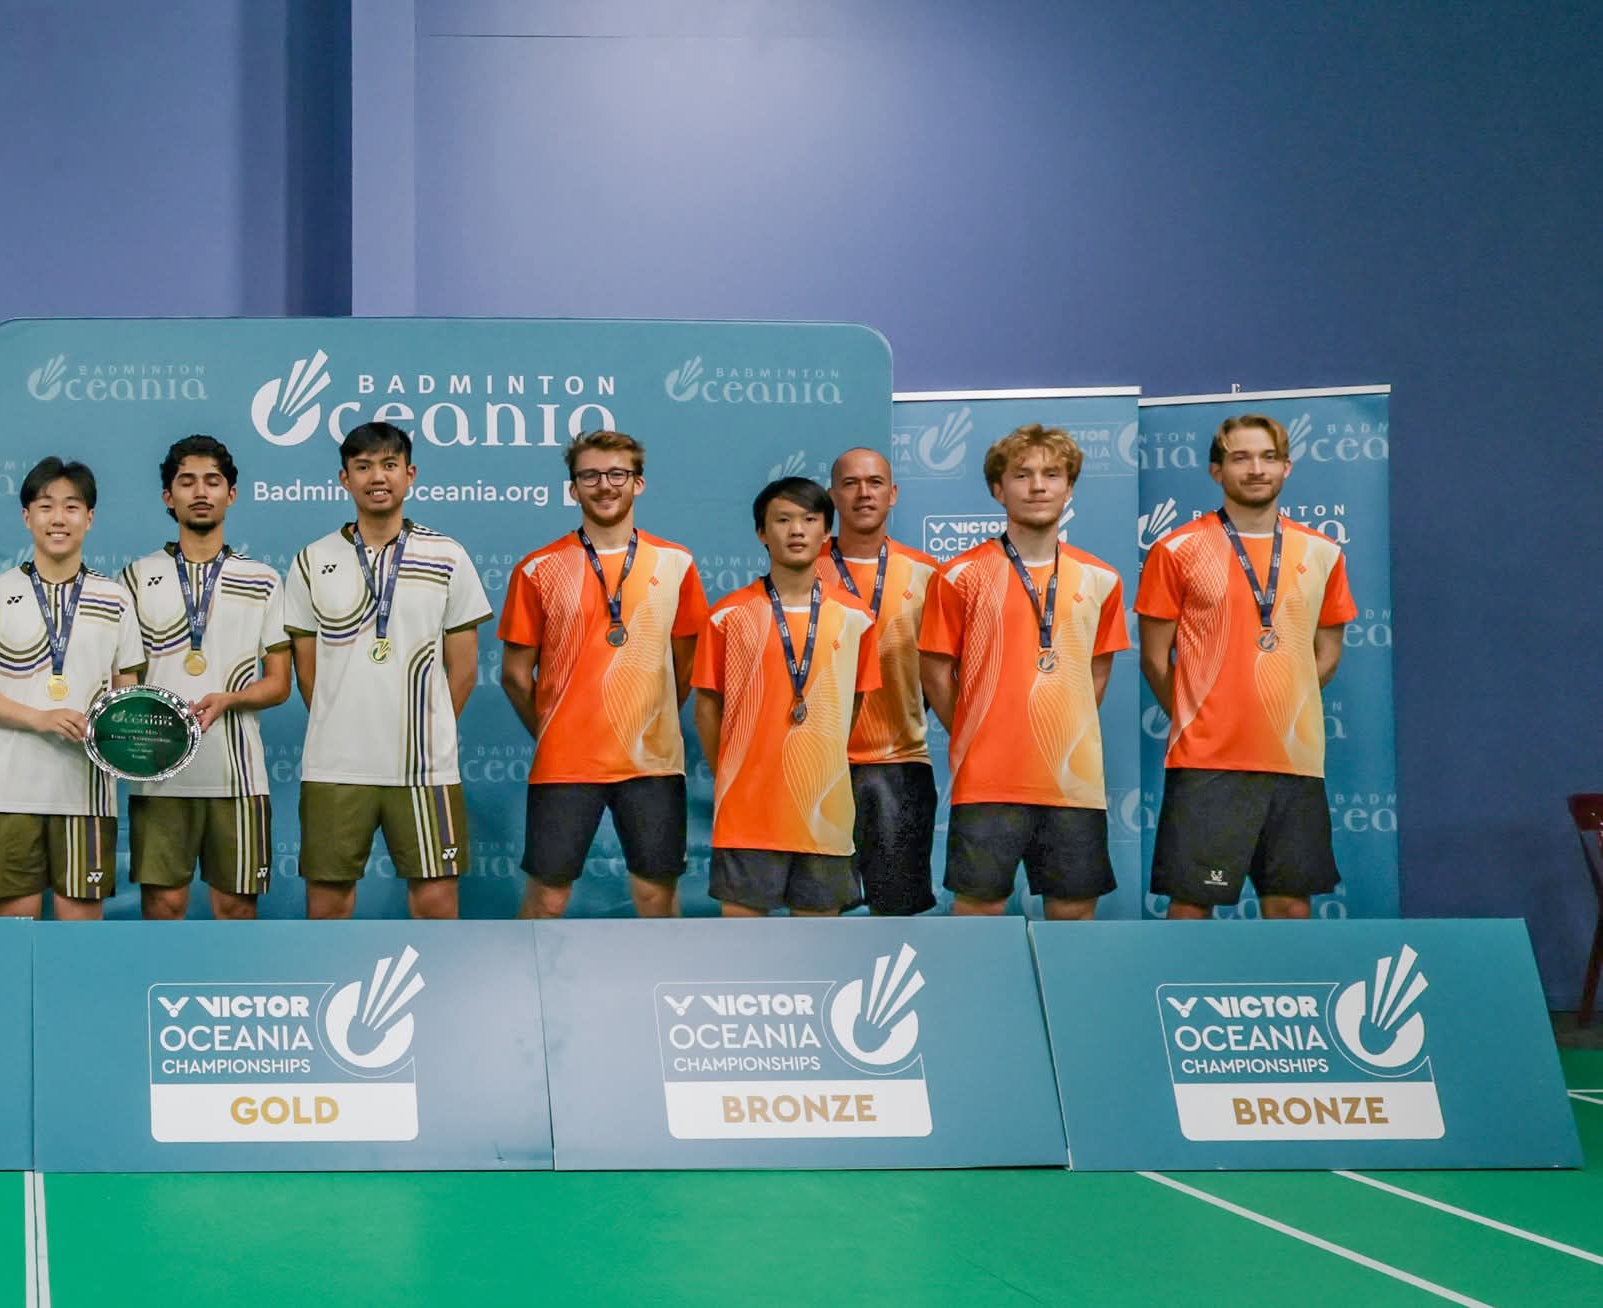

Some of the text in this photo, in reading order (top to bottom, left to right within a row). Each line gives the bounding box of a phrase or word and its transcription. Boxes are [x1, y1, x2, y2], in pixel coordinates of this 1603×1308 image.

[78, 365, 206, 376] BADMINTON
[358, 374, 615, 396] BADMINTON
[195, 995, 310, 1018] VICTOR
[701, 994, 814, 1016] VICTOR
[1203, 996, 1319, 1018] VICTOR
[159, 1024, 314, 1052] OCEANIA
[669, 1023, 822, 1050] OCEANIA
[1174, 1024, 1329, 1052] OCEANIA
[161, 1058, 311, 1074] CHAMPIONSHIPS
[673, 1055, 821, 1072] CHAMPIONSHIPS
[1181, 1058, 1329, 1074] CHAMPIONSHIPS
[230, 1096, 339, 1125] GOLD
[721, 1094, 877, 1124] BRONZE
[1232, 1097, 1389, 1125] BRONZE
